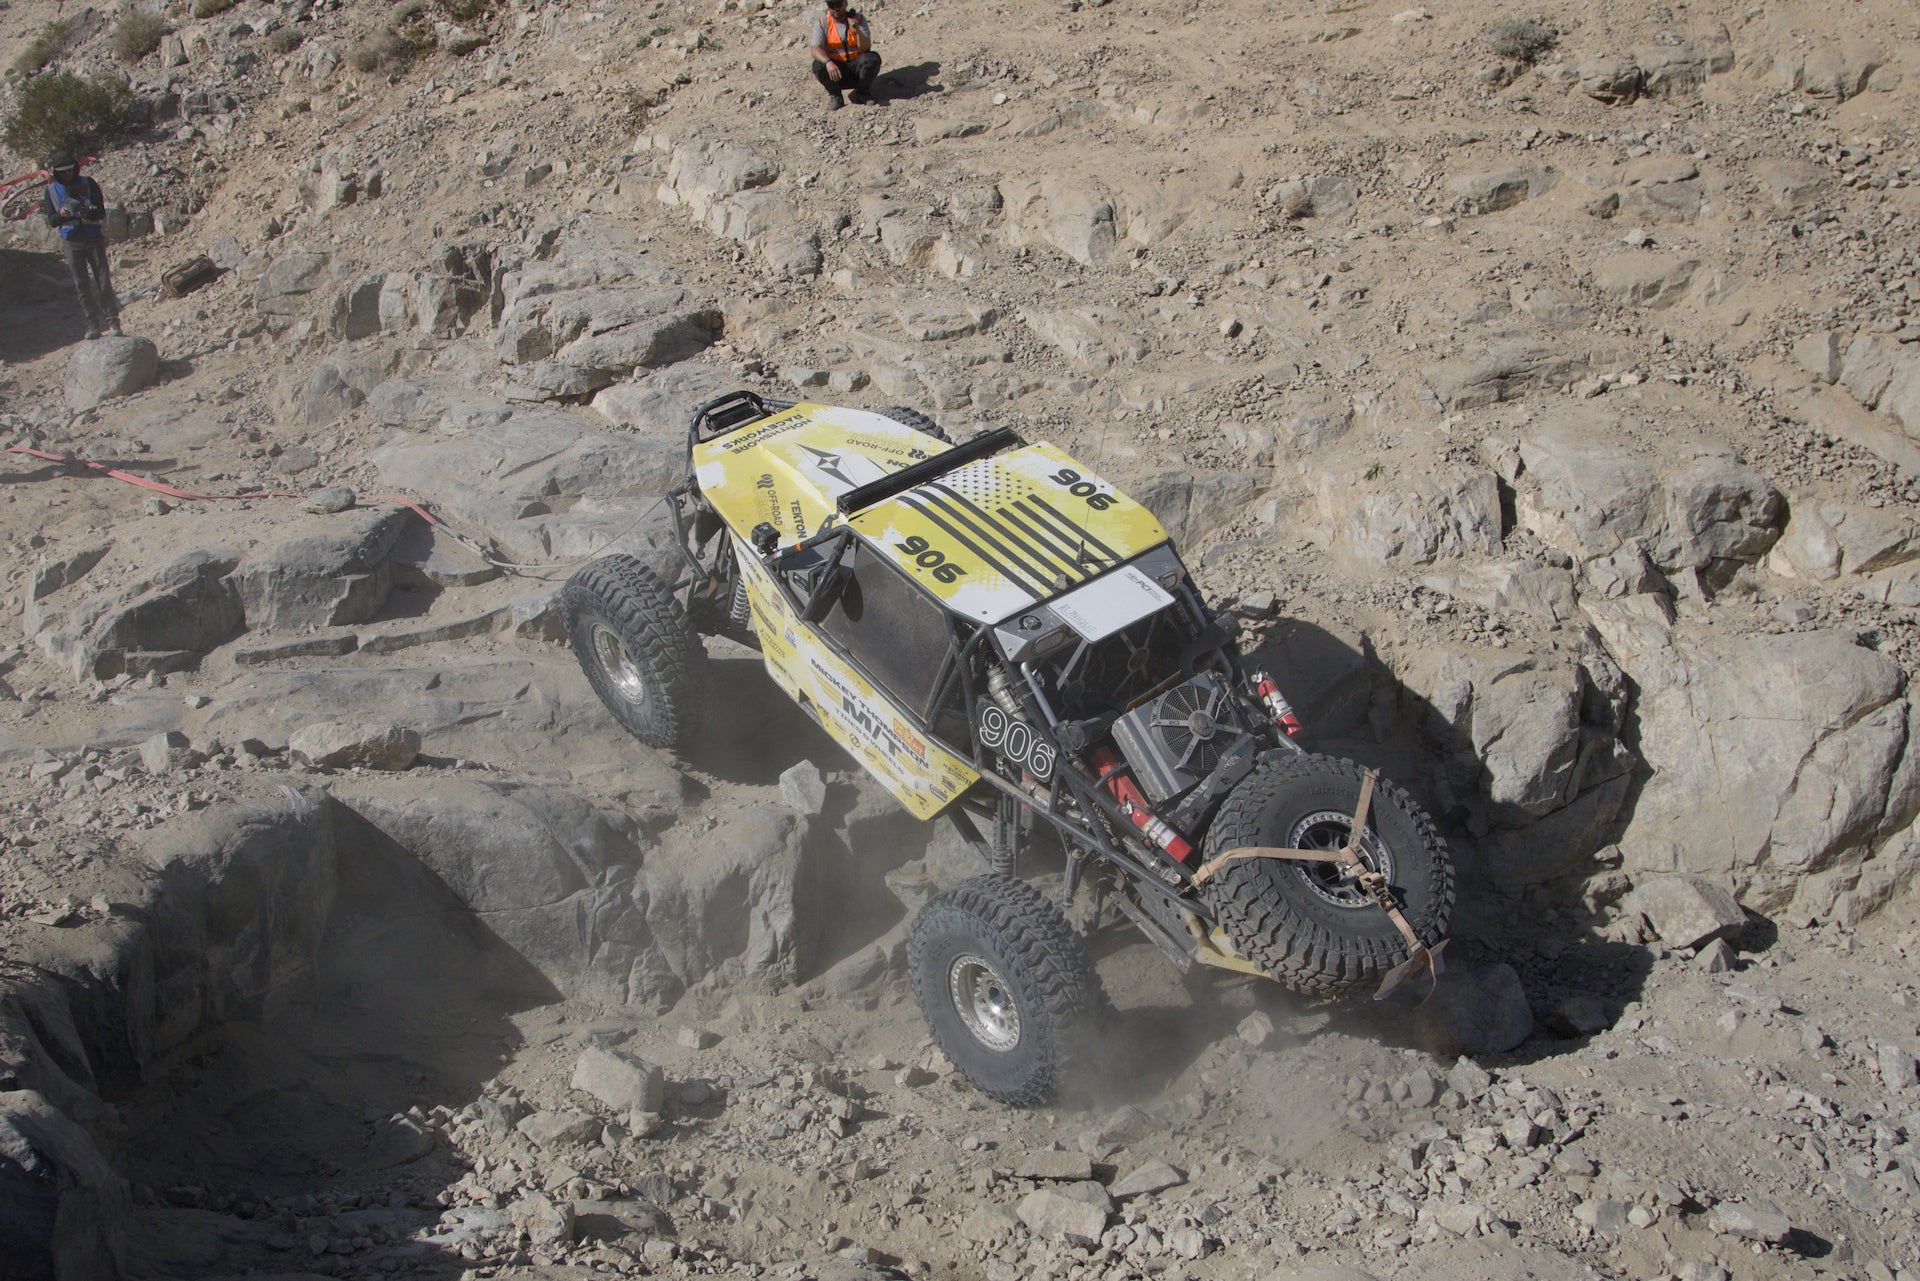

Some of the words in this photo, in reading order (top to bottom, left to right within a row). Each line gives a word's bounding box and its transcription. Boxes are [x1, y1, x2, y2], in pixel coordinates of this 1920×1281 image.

[722, 413, 804, 450] RACEWORKS
[731, 418, 813, 455] NORTHSHORE
[846, 438, 904, 456] OFF-ROAD
[767, 489, 783, 526] OFF-ROAD
[1048, 467, 1120, 511] 906
[790, 499, 808, 539] TEKTON
[894, 535, 969, 584] 906
[1135, 580, 1153, 592] PCI
[810, 658, 857, 700] MICKEY
[859, 699, 929, 769] THOMPSON
[842, 696, 903, 757] M/T
[834, 706, 862, 734] TIRES
[870, 740, 904, 775] WHEELS
[979, 706, 1056, 778] 906
